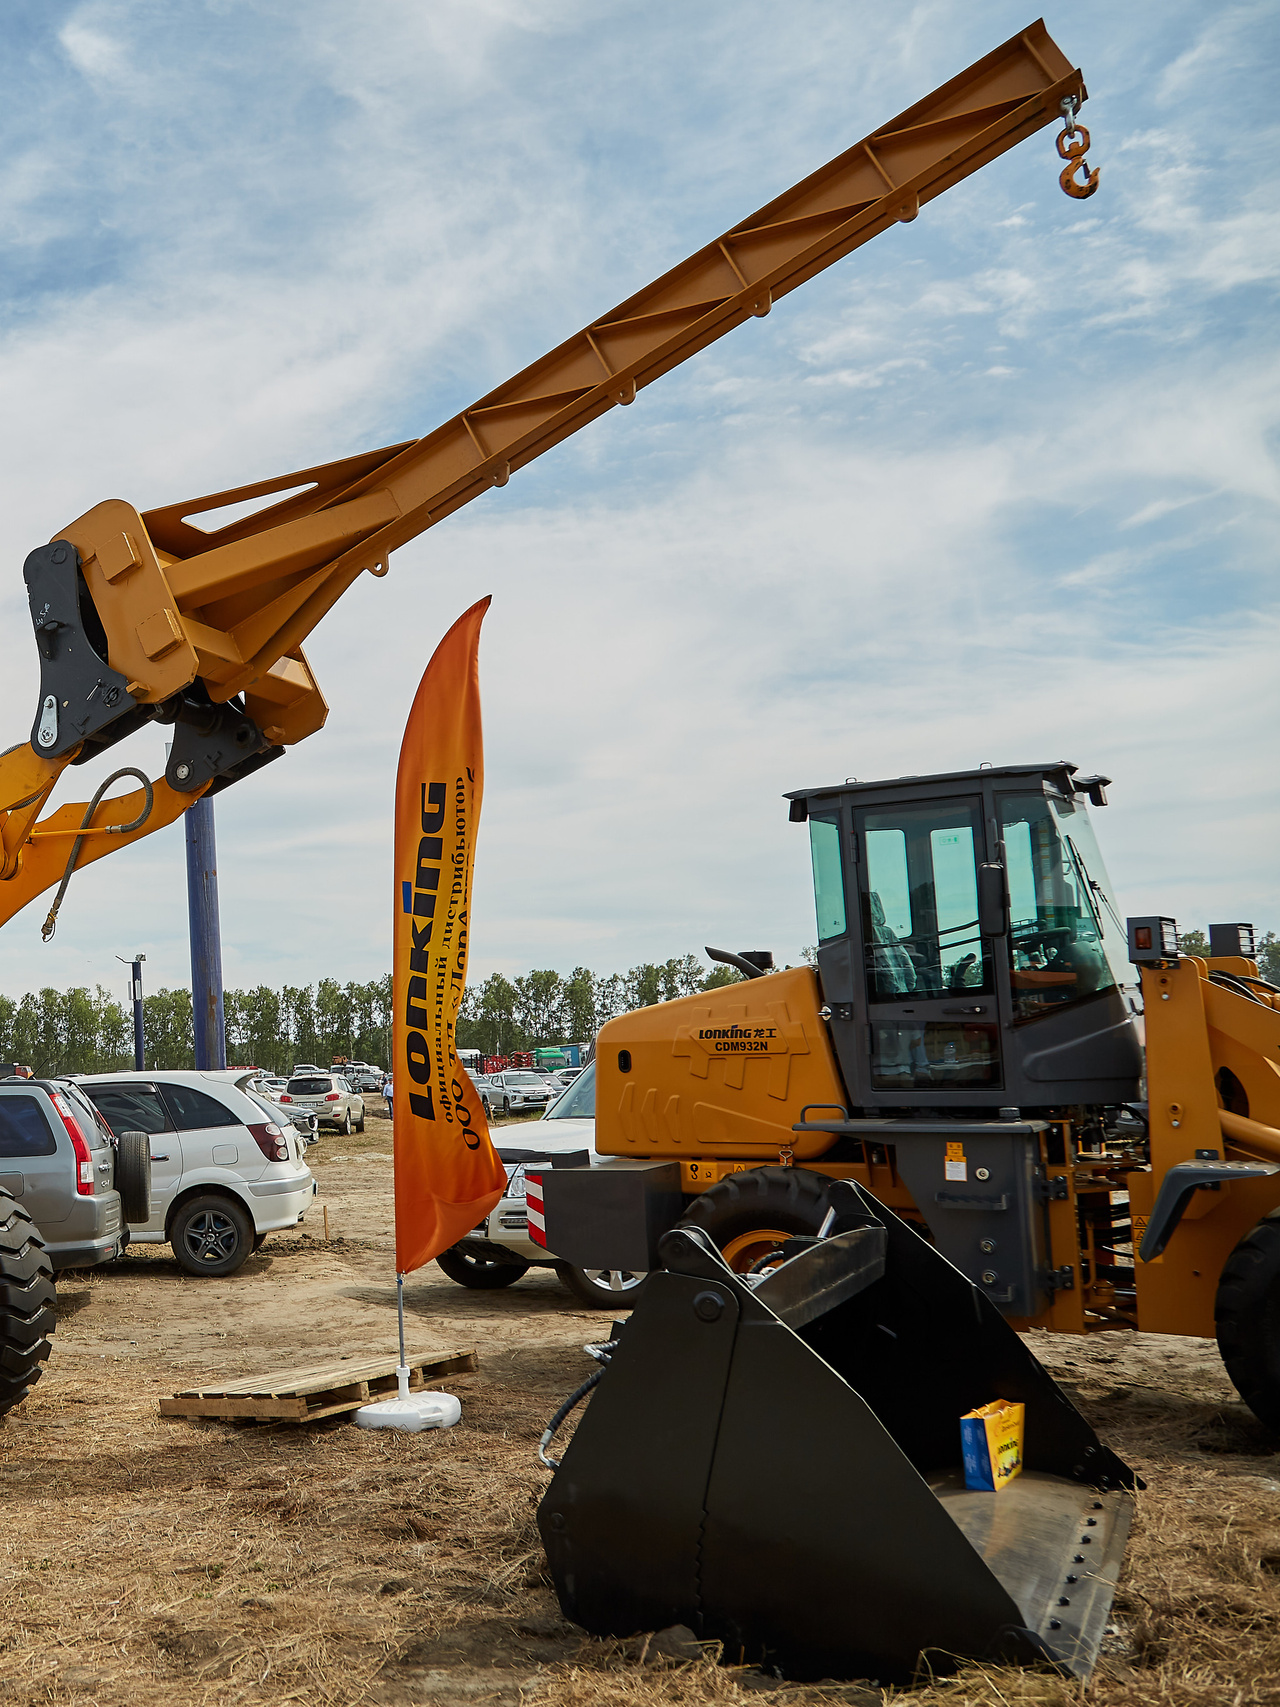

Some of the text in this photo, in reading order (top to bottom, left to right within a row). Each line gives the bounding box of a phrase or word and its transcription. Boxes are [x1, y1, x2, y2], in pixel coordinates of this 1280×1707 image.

[434, 776, 465, 1125] официальный дистрибьютор
[715, 1041, 768, 1052] CDM932N
[451, 1077, 482, 1151] ООО
